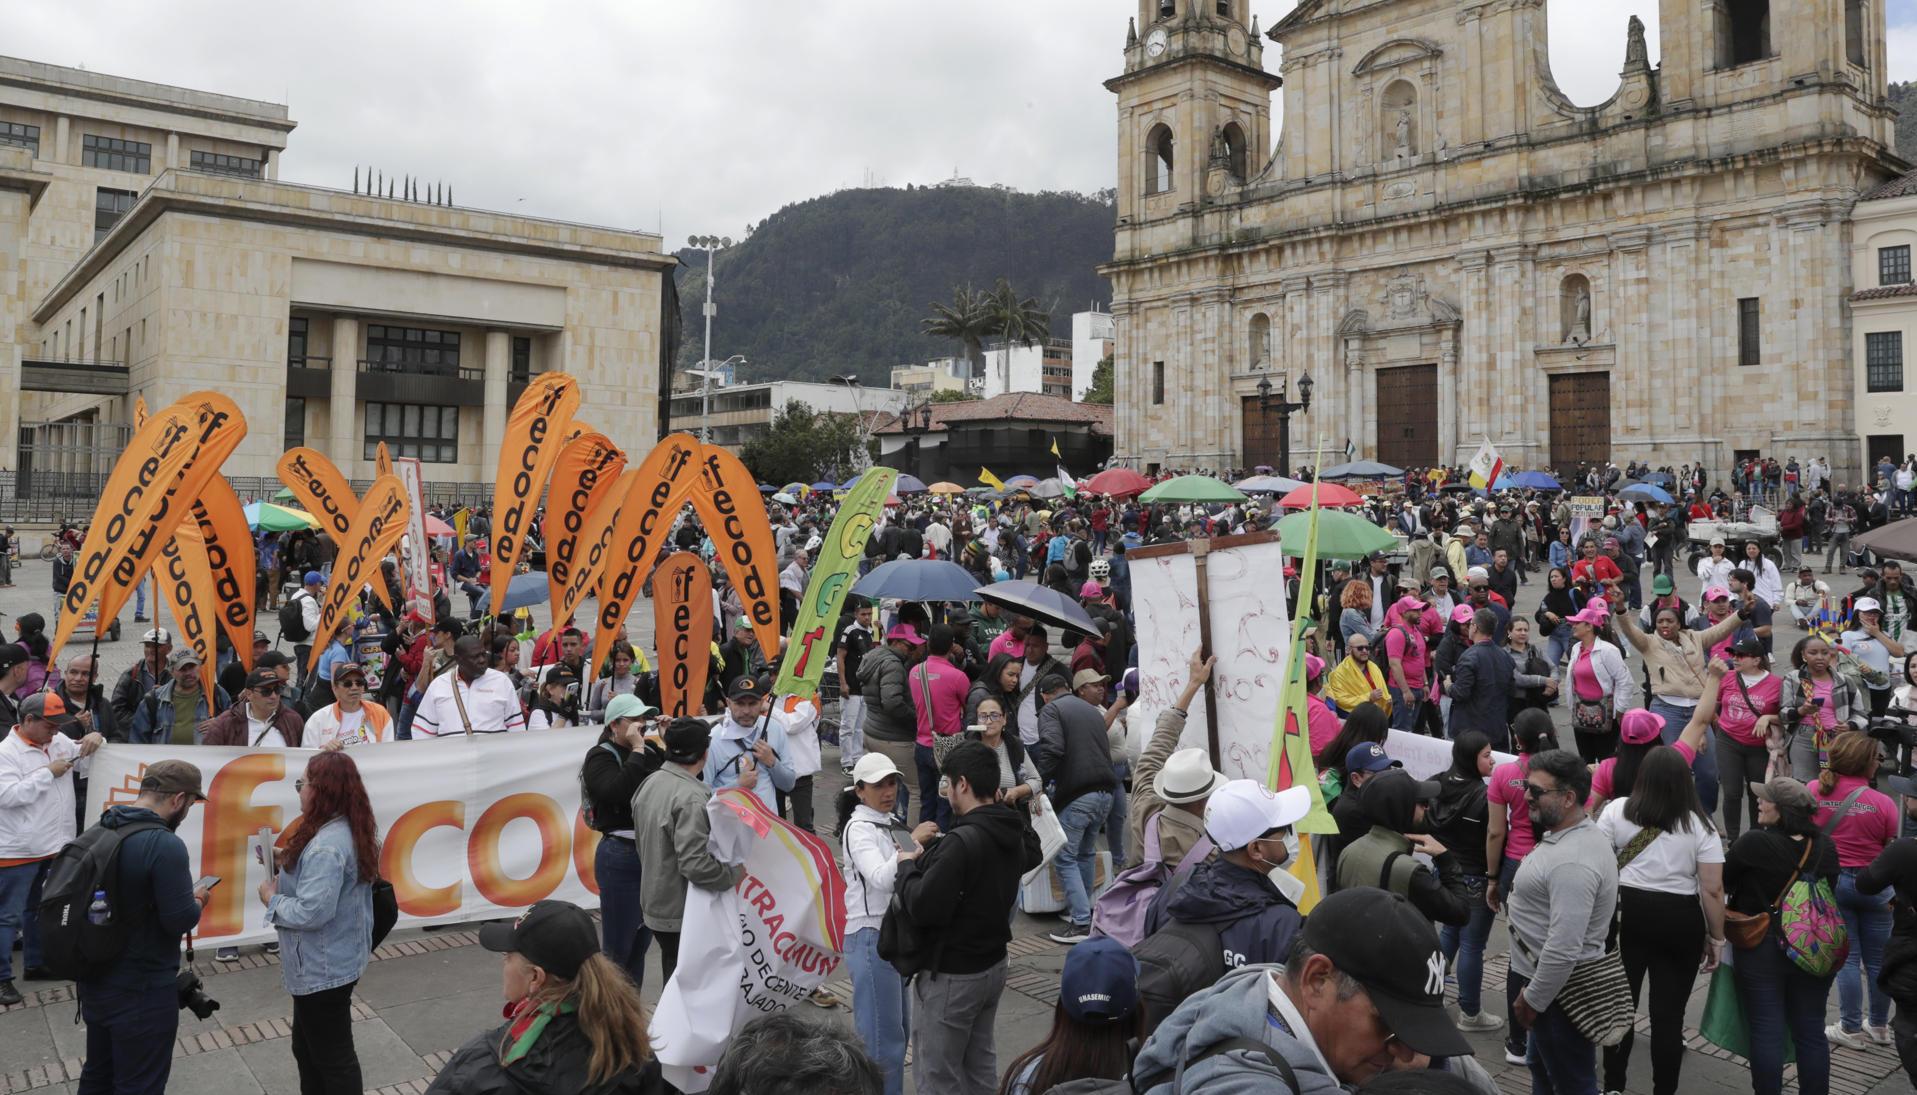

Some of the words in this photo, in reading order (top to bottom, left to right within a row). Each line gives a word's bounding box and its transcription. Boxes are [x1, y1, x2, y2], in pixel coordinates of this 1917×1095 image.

[66, 425, 189, 614] fecode
[497, 386, 566, 563] fecode
[552, 450, 619, 586] fecode
[602, 450, 692, 630] fecode
[708, 454, 773, 626] fecode
[323, 500, 402, 632] fecode
[751, 949, 807, 1000] DECENTE
[1424, 950, 1447, 995] NY
